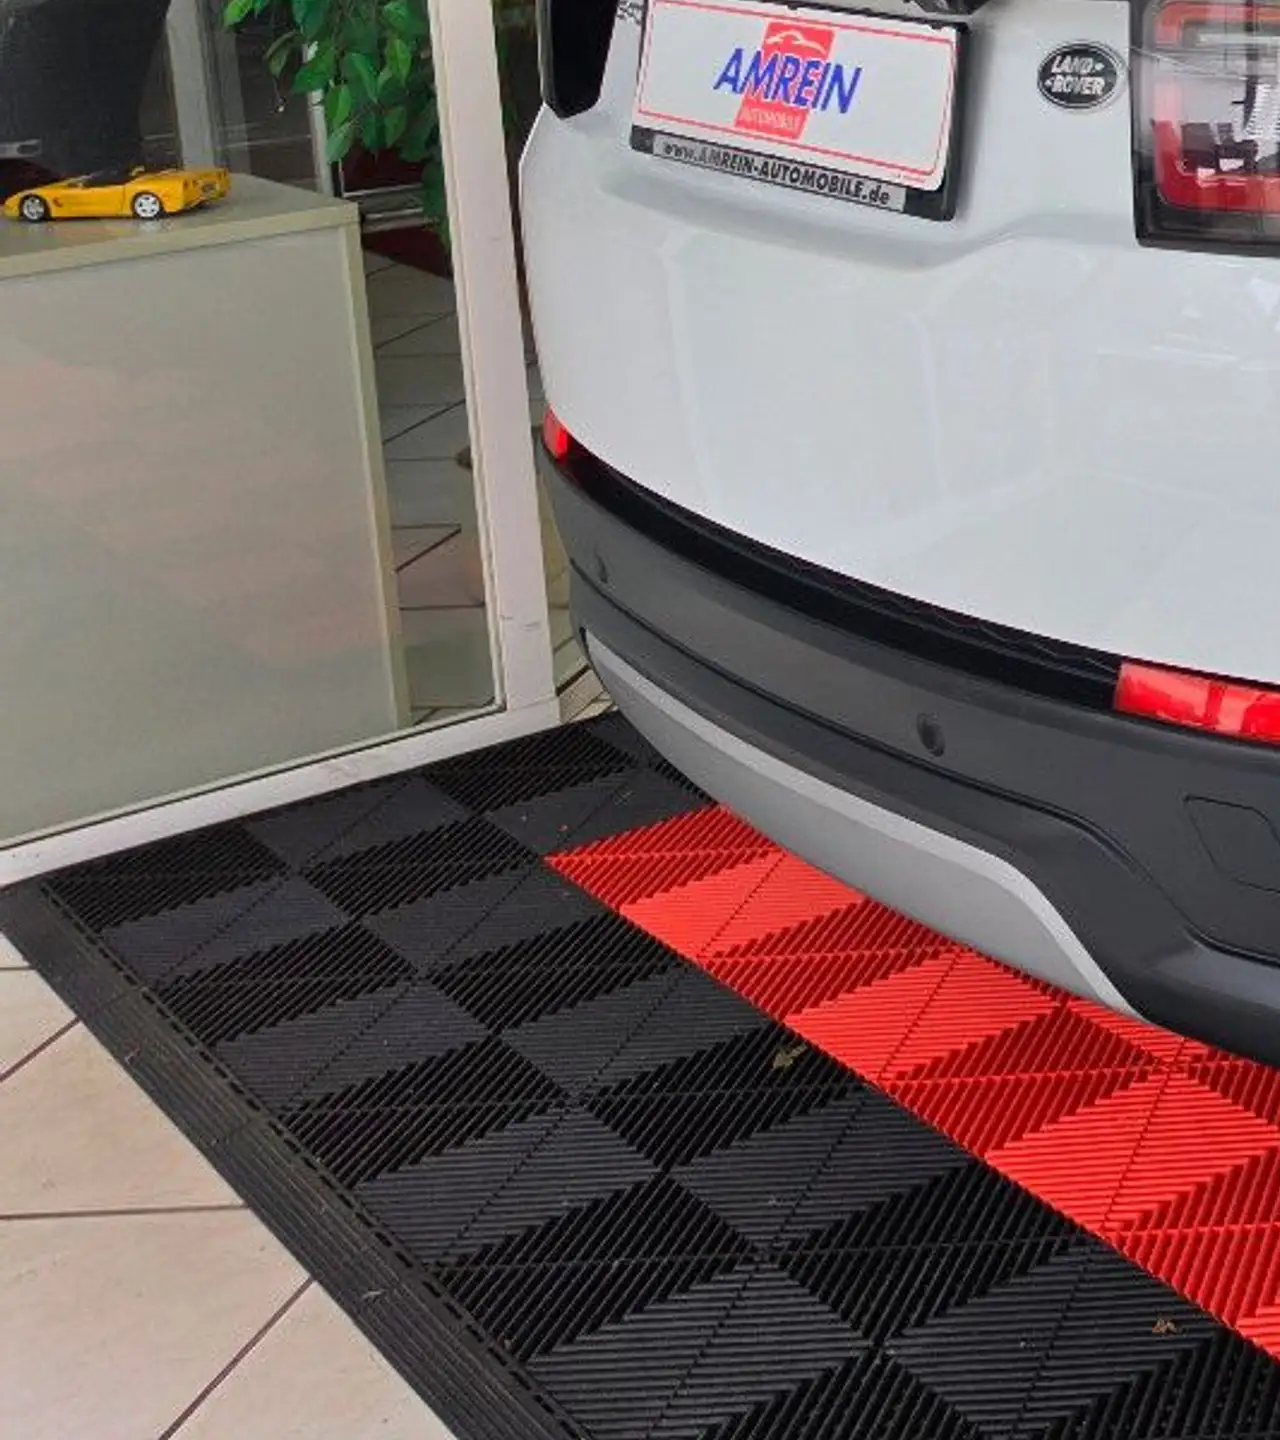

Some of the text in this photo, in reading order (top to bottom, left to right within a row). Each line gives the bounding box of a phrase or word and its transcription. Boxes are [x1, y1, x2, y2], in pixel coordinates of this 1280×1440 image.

[713, 47, 864, 114] AMREIN
[1051, 55, 1094, 75] LAND
[1051, 74, 1105, 96] ROVER
[663, 140, 891, 206] www.AMREIN-AUTOMOBILE.de
